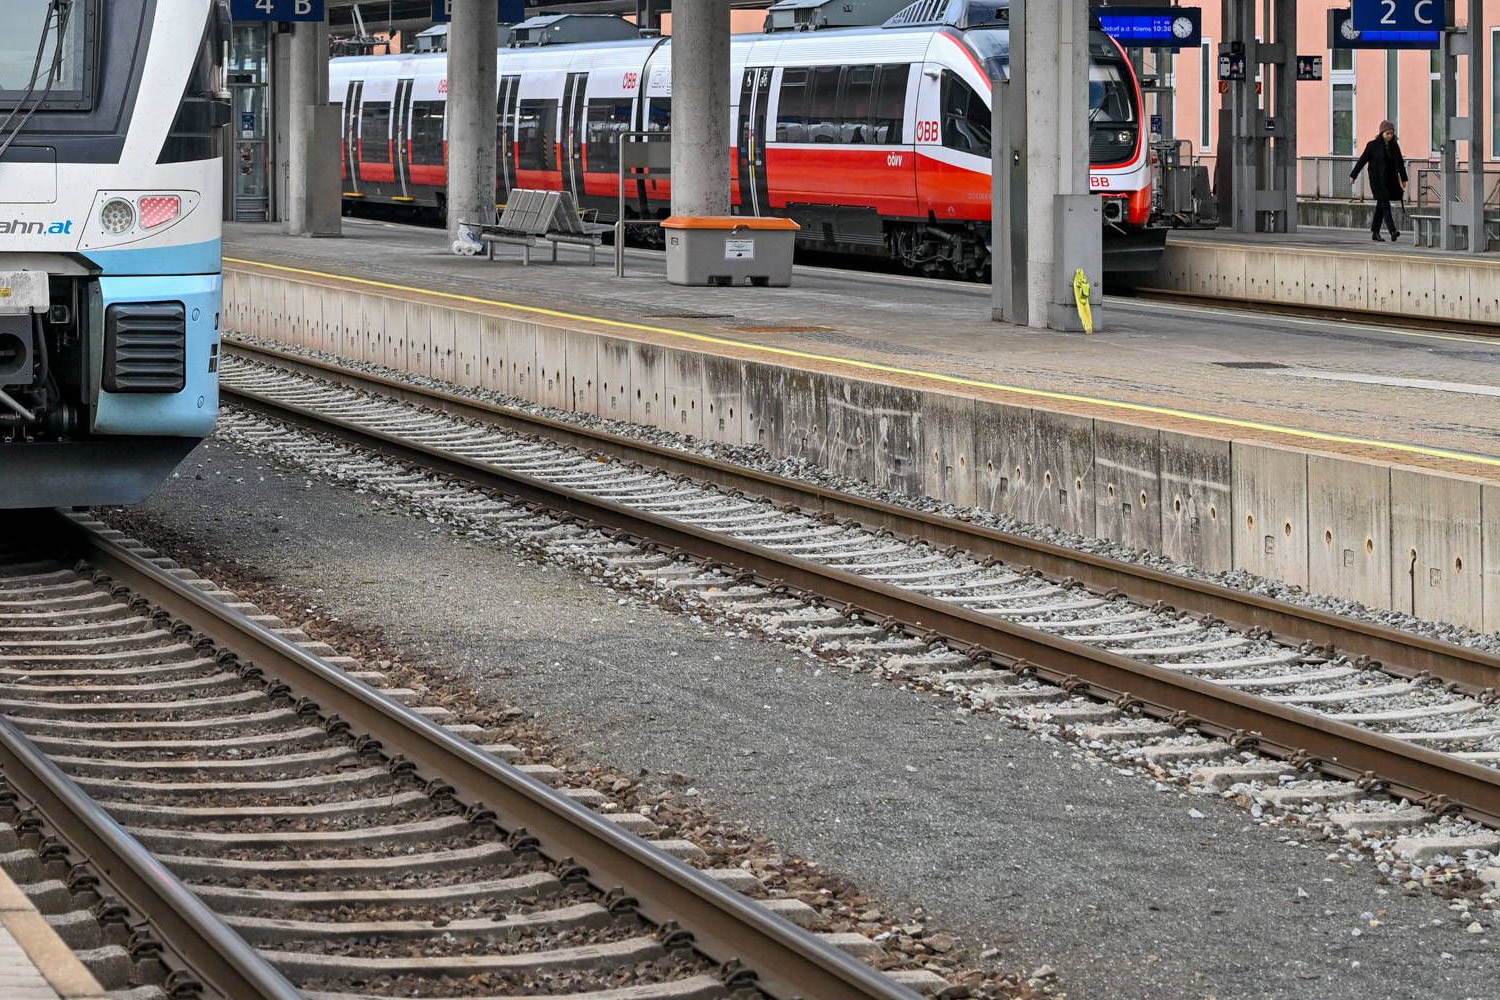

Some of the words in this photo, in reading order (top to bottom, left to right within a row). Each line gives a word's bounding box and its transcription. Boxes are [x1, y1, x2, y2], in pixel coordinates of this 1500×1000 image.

[1380, 0, 1397, 25] 2
[1414, 0, 1433, 25] C
[1090, 177, 1110, 187] BB
